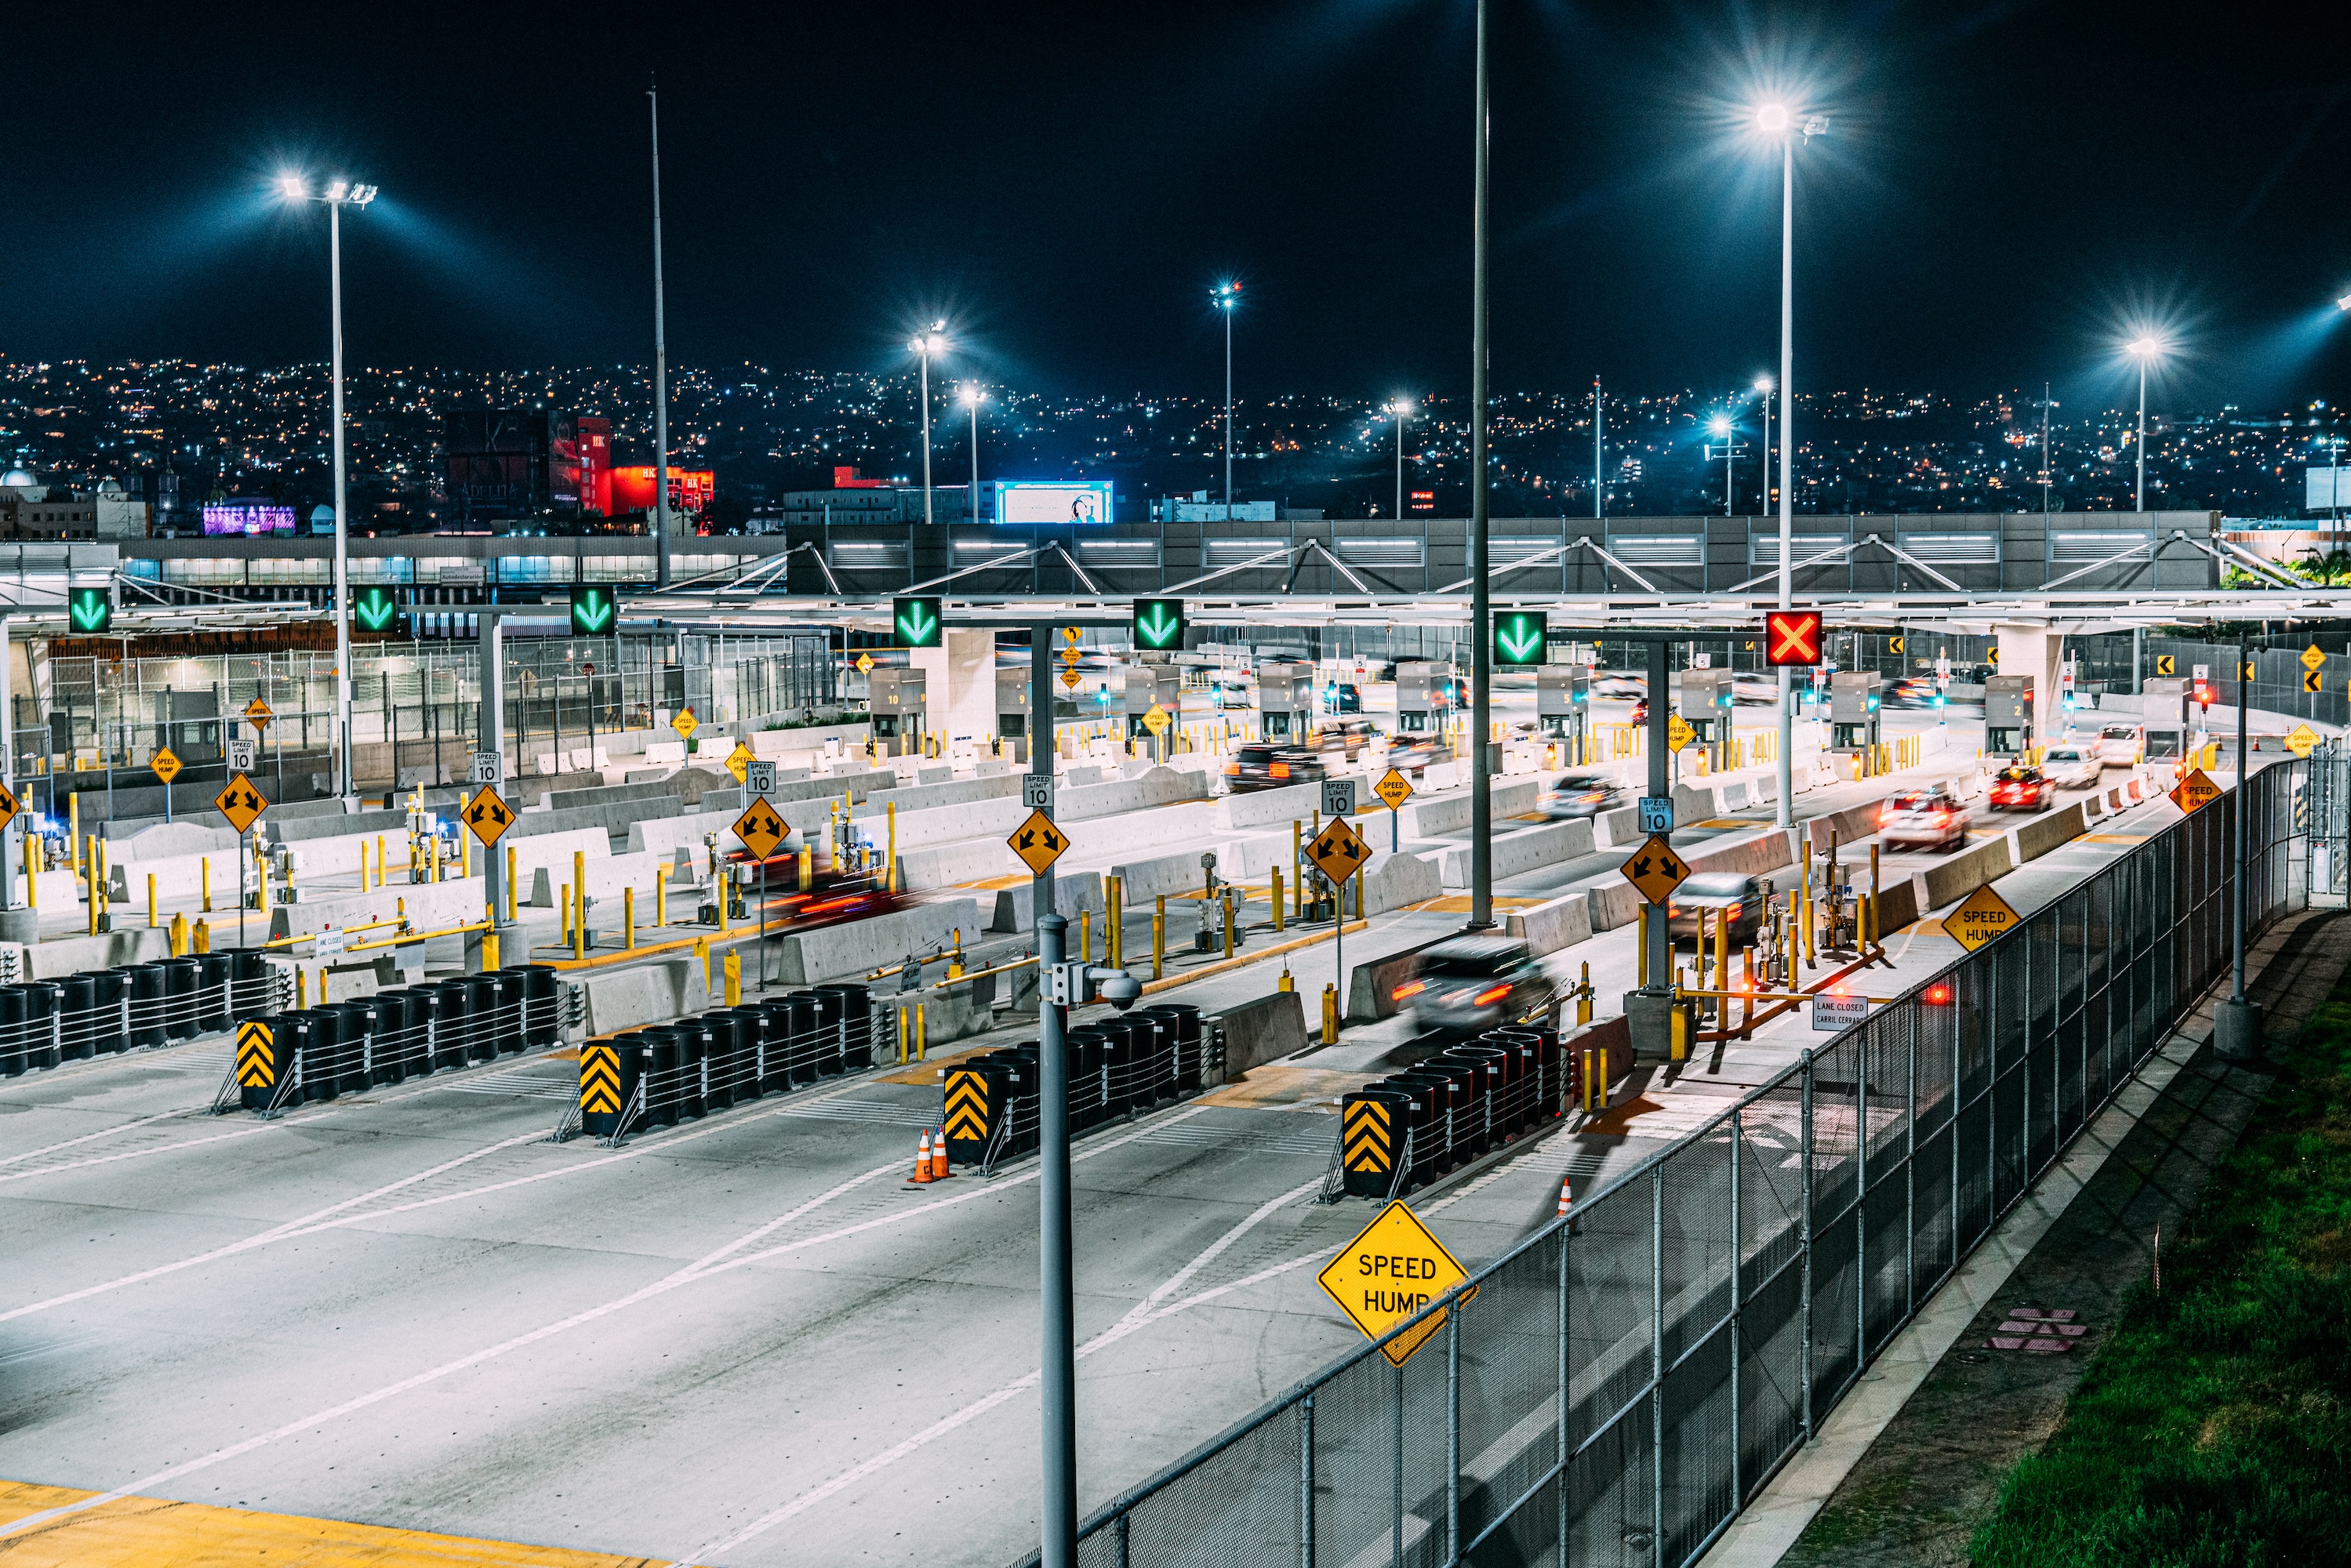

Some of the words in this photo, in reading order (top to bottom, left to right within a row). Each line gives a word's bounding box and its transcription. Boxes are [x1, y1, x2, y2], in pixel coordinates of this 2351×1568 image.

[642, 468, 656, 478] HK
[687, 478, 698, 488] HK
[888, 695, 899, 704] 10
[1019, 695, 1025, 704] 9
[1150, 694, 1156, 703] 8
[1285, 691, 1291, 702] 7
[1422, 690, 1428, 700] 6
[1564, 694, 1570, 703] 5
[1708, 698, 1715, 708] 4
[1859, 702, 1866, 713] 3
[2014, 706, 2021, 716] 2
[234, 754, 249, 768] 10
[479, 767, 495, 780] 10
[753, 777, 769, 790] 10
[2183, 786, 2213, 795] SPEED
[1030, 789, 1047, 804] 10
[1328, 797, 1347, 812] 10
[1646, 814, 1666, 829] 10
[1963, 910, 2006, 924] SPEED
[318, 938, 327, 947] LANE
[328, 936, 342, 945] CLOSED
[1817, 1002, 1835, 1011] LANE
[1837, 1003, 1864, 1011] CLOSED
[1816, 1015, 1837, 1024] CARRIL
[1359, 1254, 1436, 1279] SPEED
